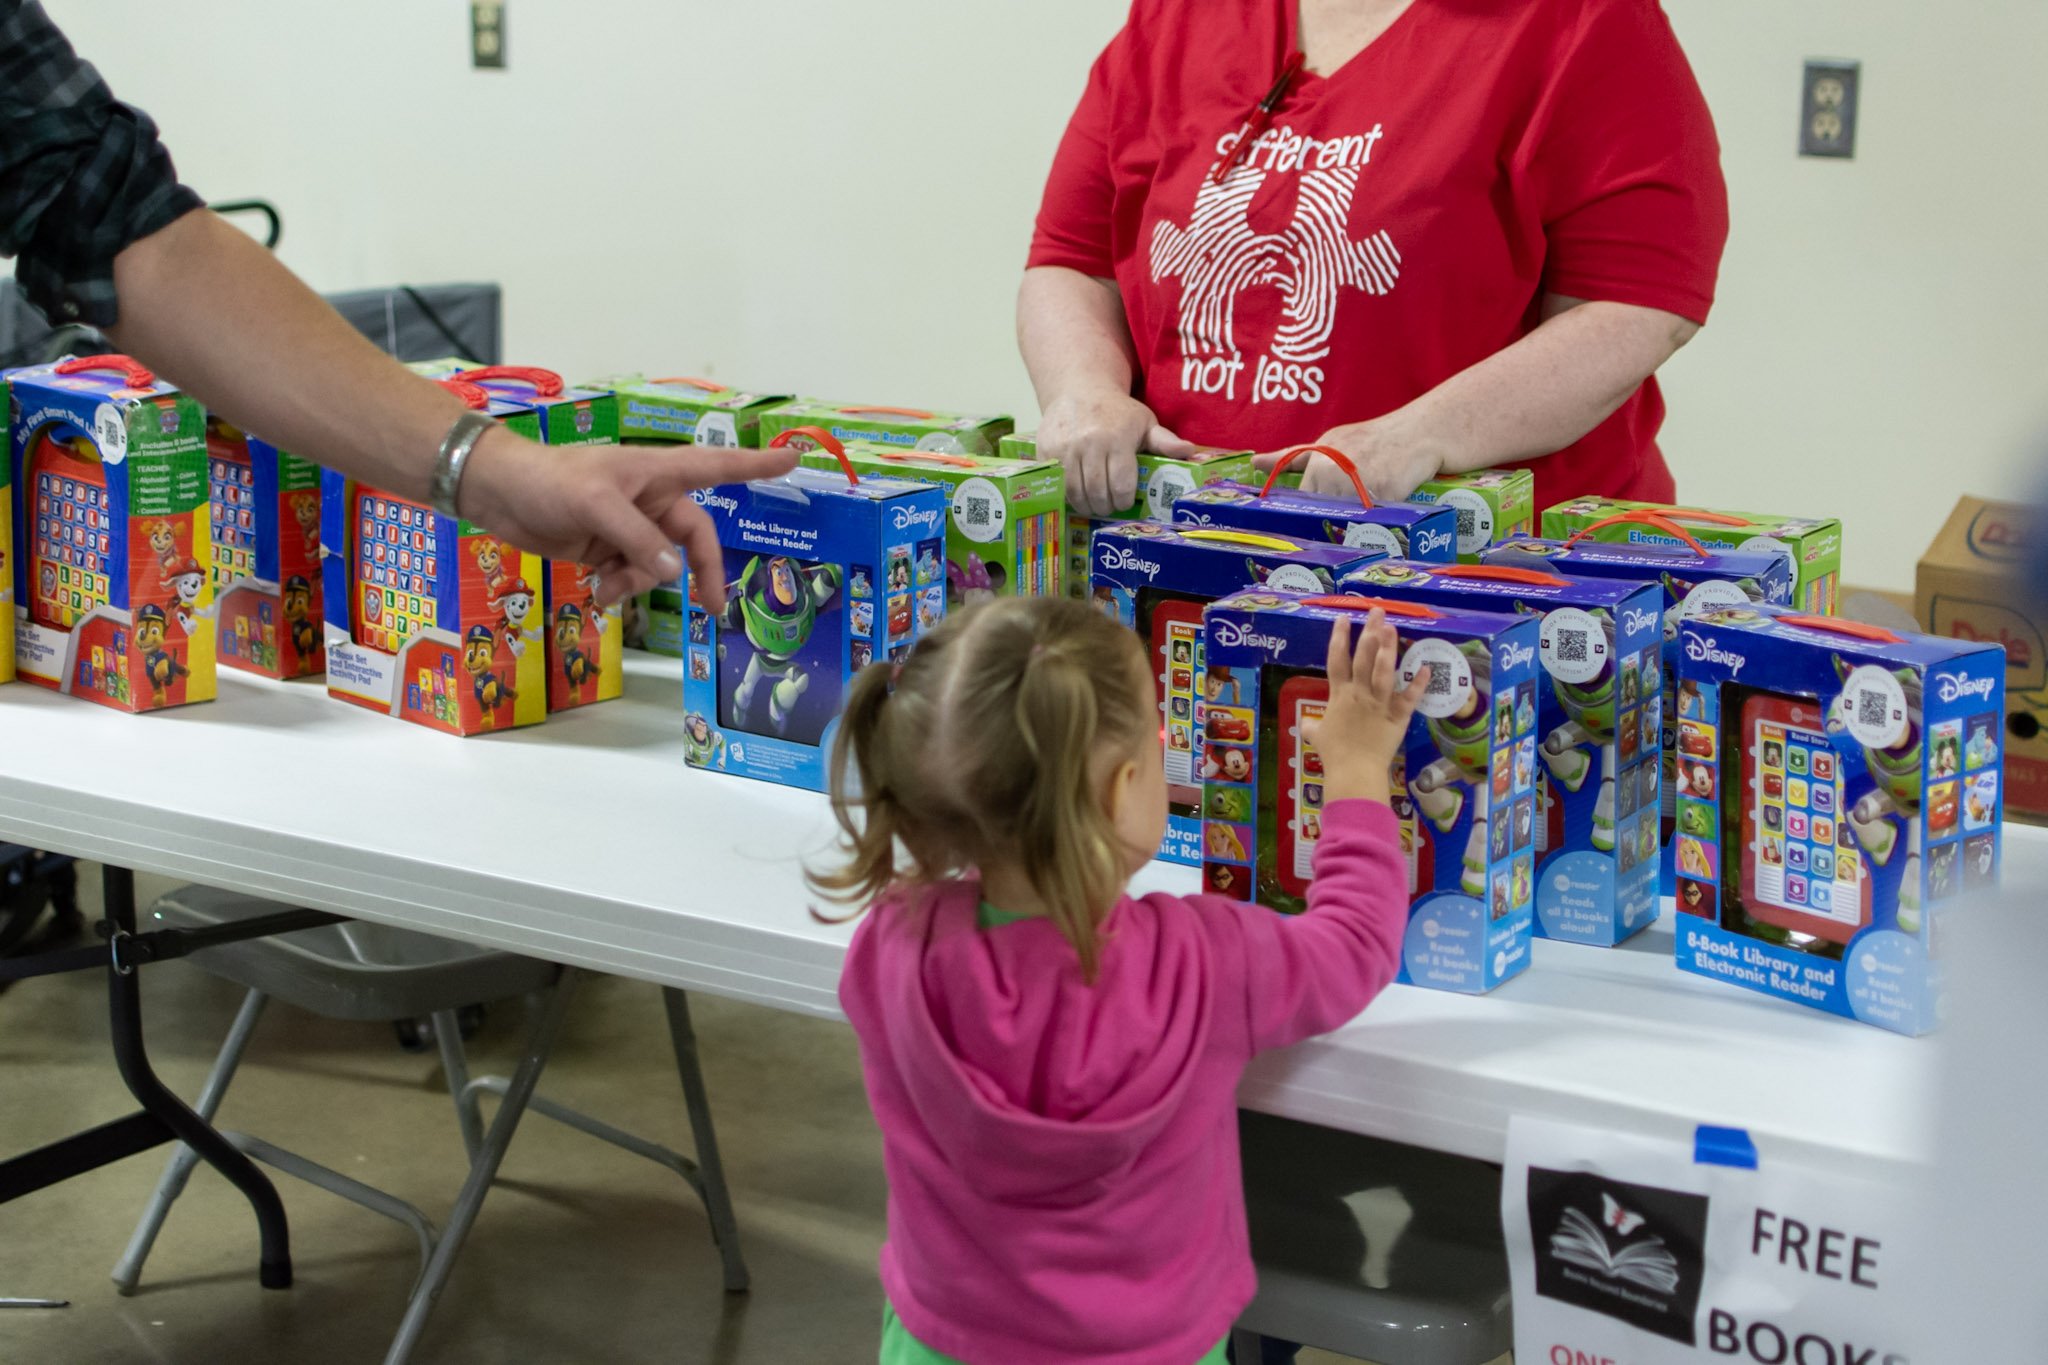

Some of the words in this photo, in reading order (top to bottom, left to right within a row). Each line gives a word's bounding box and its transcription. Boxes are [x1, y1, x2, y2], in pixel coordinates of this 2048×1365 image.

[1216, 123, 1383, 173] dfferent
[1181, 350, 1244, 400] not
[1253, 355, 1324, 404] less
[832, 427, 880, 441] Electronic
[883, 433, 917, 444] Reader
[365, 500, 372, 513] A
[377, 503, 384, 516] B
[390, 506, 397, 519] C
[402, 509, 410, 523] D
[415, 512, 422, 526] E
[429, 515, 435, 529] F
[689, 487, 738, 517] Disney
[738, 519, 767, 532] 8-Book
[768, 524, 799, 539] Library
[801, 530, 817, 539] and
[890, 505, 937, 530] Disney
[365, 522, 372, 536] H
[378, 525, 383, 538] I
[390, 528, 395, 542] J
[402, 532, 409, 545] K
[415, 535, 421, 548] L
[426, 537, 436, 552] M
[743, 532, 781, 546] Electronic
[783, 538, 813, 551] Reader
[1416, 528, 1452, 555] Disney
[1629, 531, 1690, 548] Electroni
[365, 543, 371, 556] O
[377, 546, 384, 558] P
[389, 549, 396, 564] Q
[402, 553, 409, 567] R
[414, 557, 421, 570] S
[427, 560, 434, 574] T
[1098, 542, 1160, 582] Disney
[365, 565, 371, 578] V
[375, 568, 385, 582] W
[388, 572, 395, 585] X
[401, 575, 408, 588] Y
[414, 579, 421, 592] Z
[1486, 583, 1533, 592] Library
[387, 593, 392, 606] 1
[399, 596, 405, 610] 2
[412, 600, 418, 614] 3
[424, 603, 431, 616] 4
[1174, 626, 1192, 636] Book
[1623, 608, 1658, 637] Disney
[1211, 618, 1287, 660] Disney
[1499, 642, 1534, 671] Disney
[1682, 630, 1746, 677] Disney
[1935, 671, 1995, 702] Disney
[1764, 726, 1782, 736] Book
[1791, 731, 1809, 742] Read
[1810, 736, 1829, 748] Story
[1165, 823, 1203, 842] brar
[1561, 895, 1595, 909] Reads
[1574, 908, 1609, 923] books
[1686, 930, 1739, 960] 8-Book
[1743, 946, 1800, 979] Library
[1804, 967, 1835, 986] and
[1694, 951, 1766, 984] Electronic
[1770, 972, 1827, 1002] Reader
[1751, 1207, 1882, 1291] FREE
